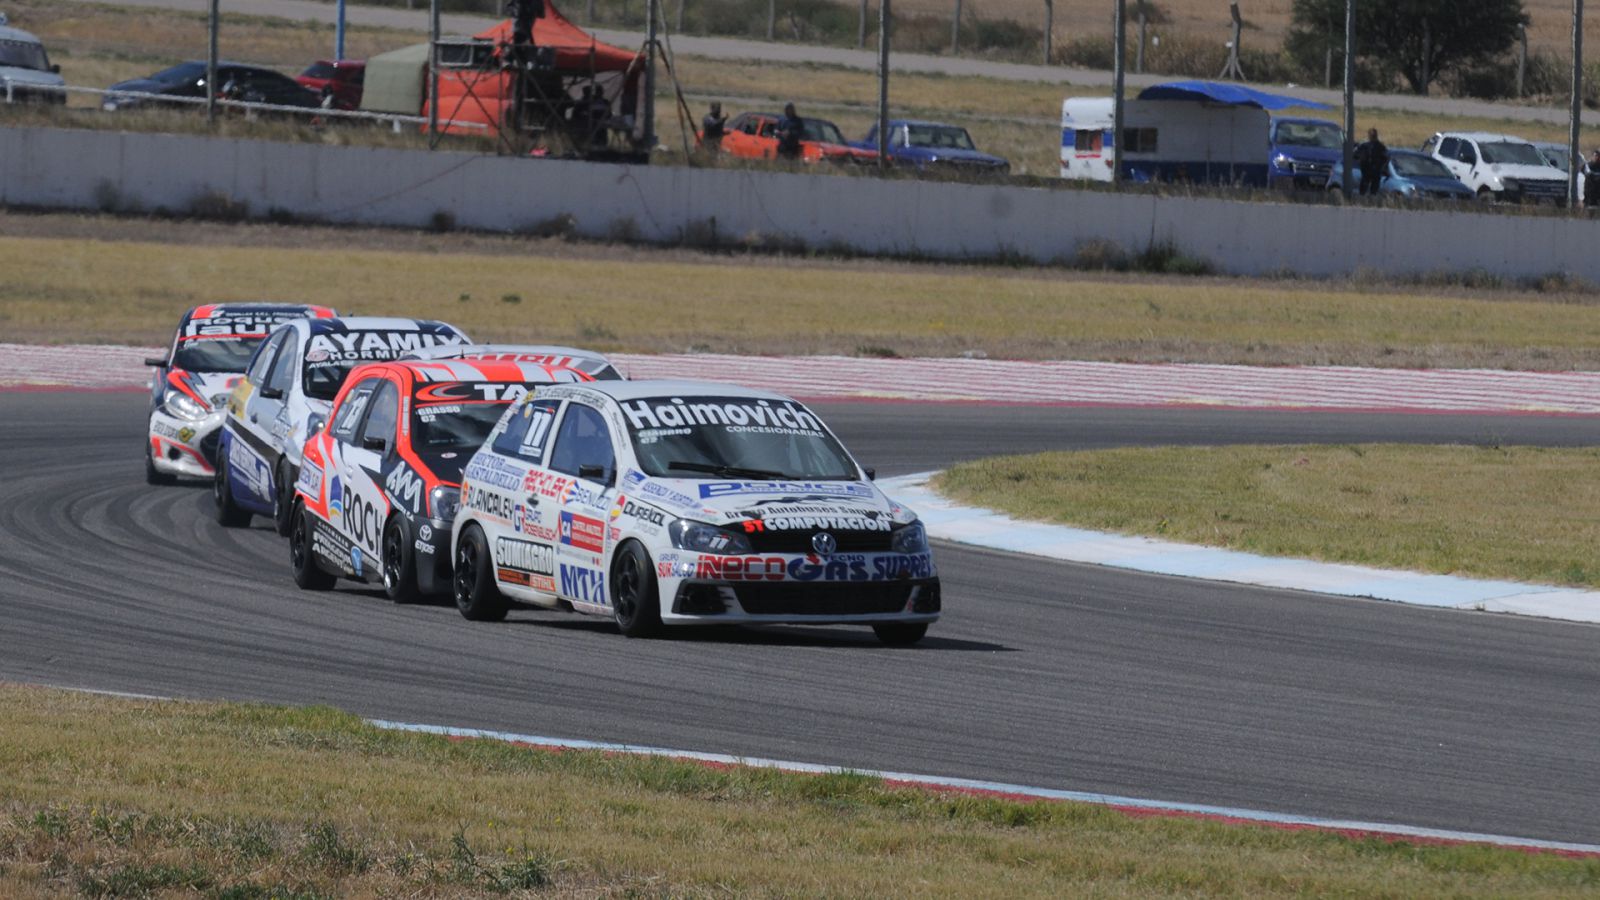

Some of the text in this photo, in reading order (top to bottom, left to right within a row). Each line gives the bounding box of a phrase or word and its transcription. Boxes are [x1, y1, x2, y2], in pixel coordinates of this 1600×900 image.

[523, 410, 552, 447] 11
[621, 396, 822, 431] Haimovich
[725, 424, 824, 439] CONCESIONARIAS
